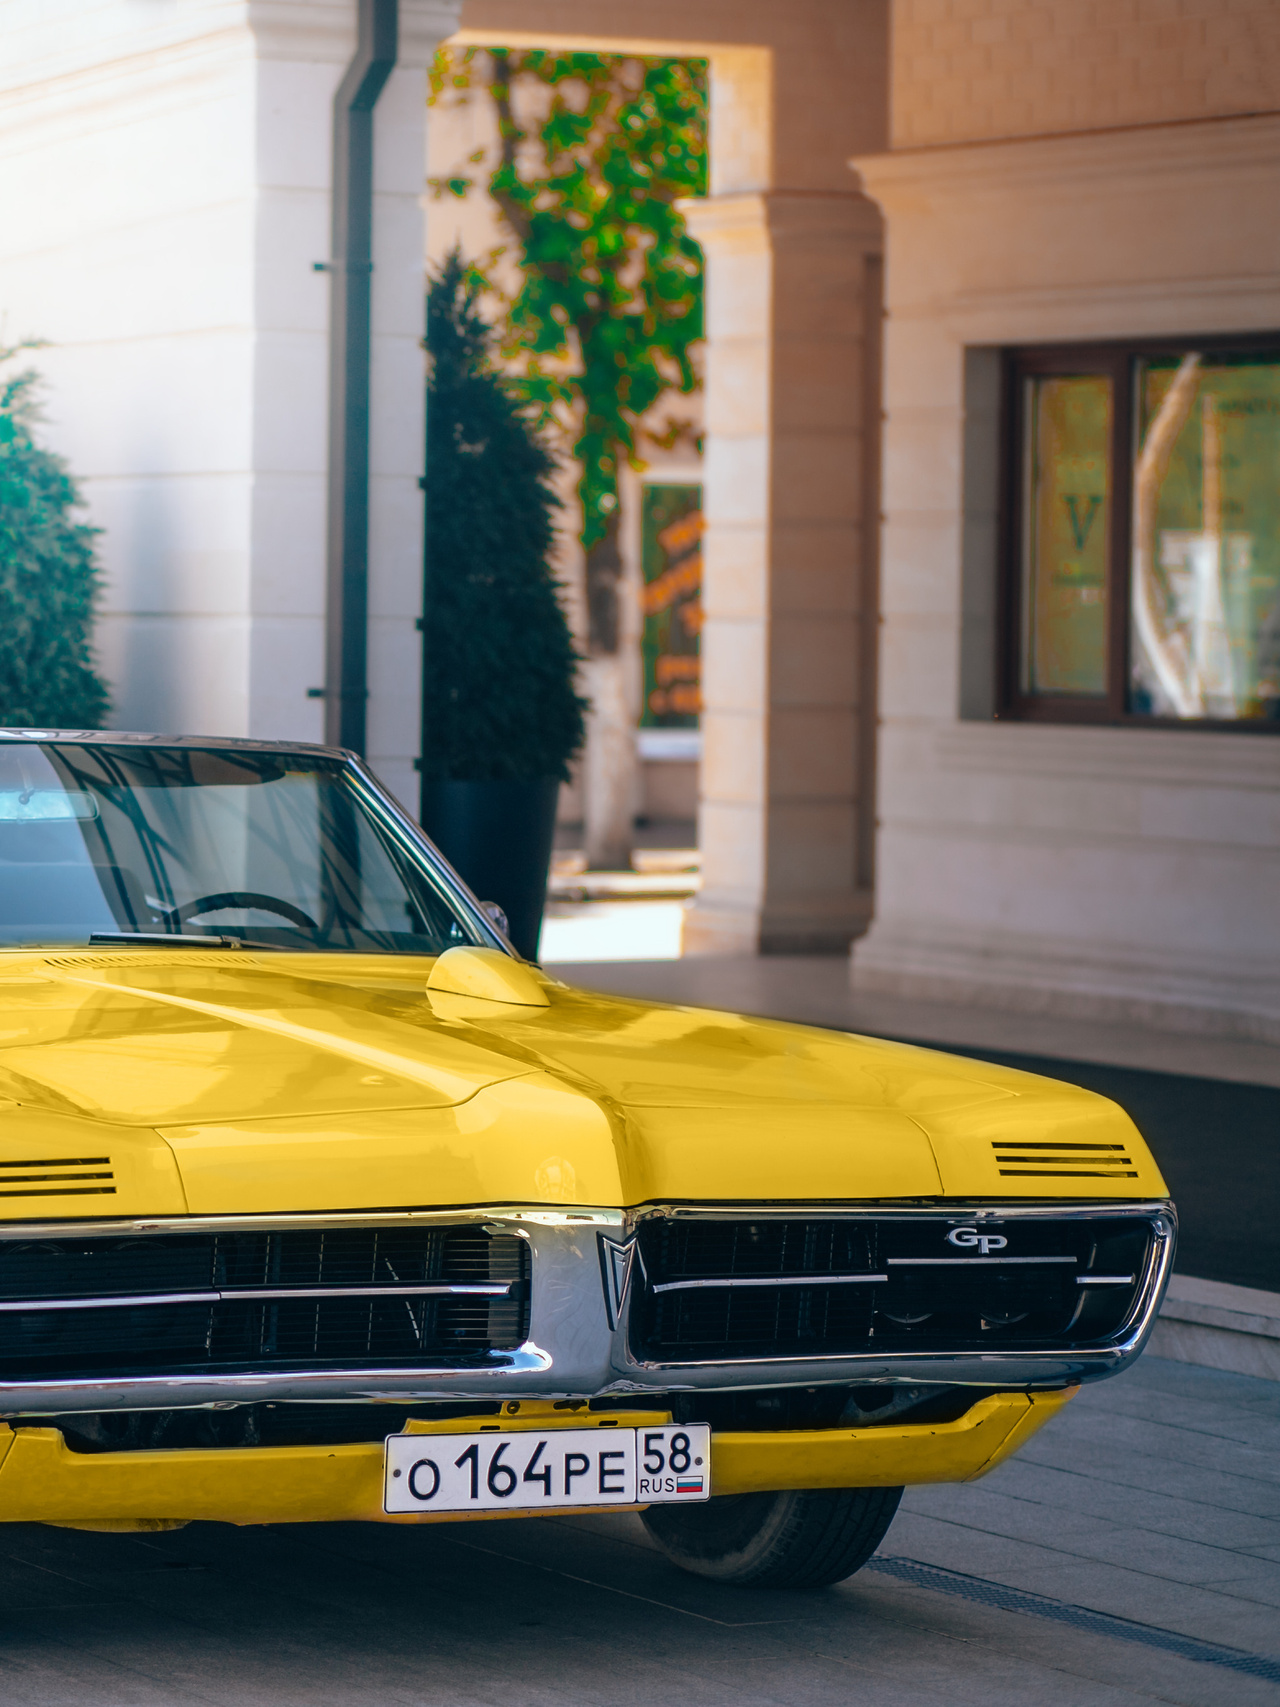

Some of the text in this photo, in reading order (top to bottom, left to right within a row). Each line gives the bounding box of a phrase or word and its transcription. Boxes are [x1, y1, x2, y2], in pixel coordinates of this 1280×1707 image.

[948, 1227, 1008, 1254] GP
[643, 1432, 691, 1474] 58
[640, 1477, 675, 1494] RUS
